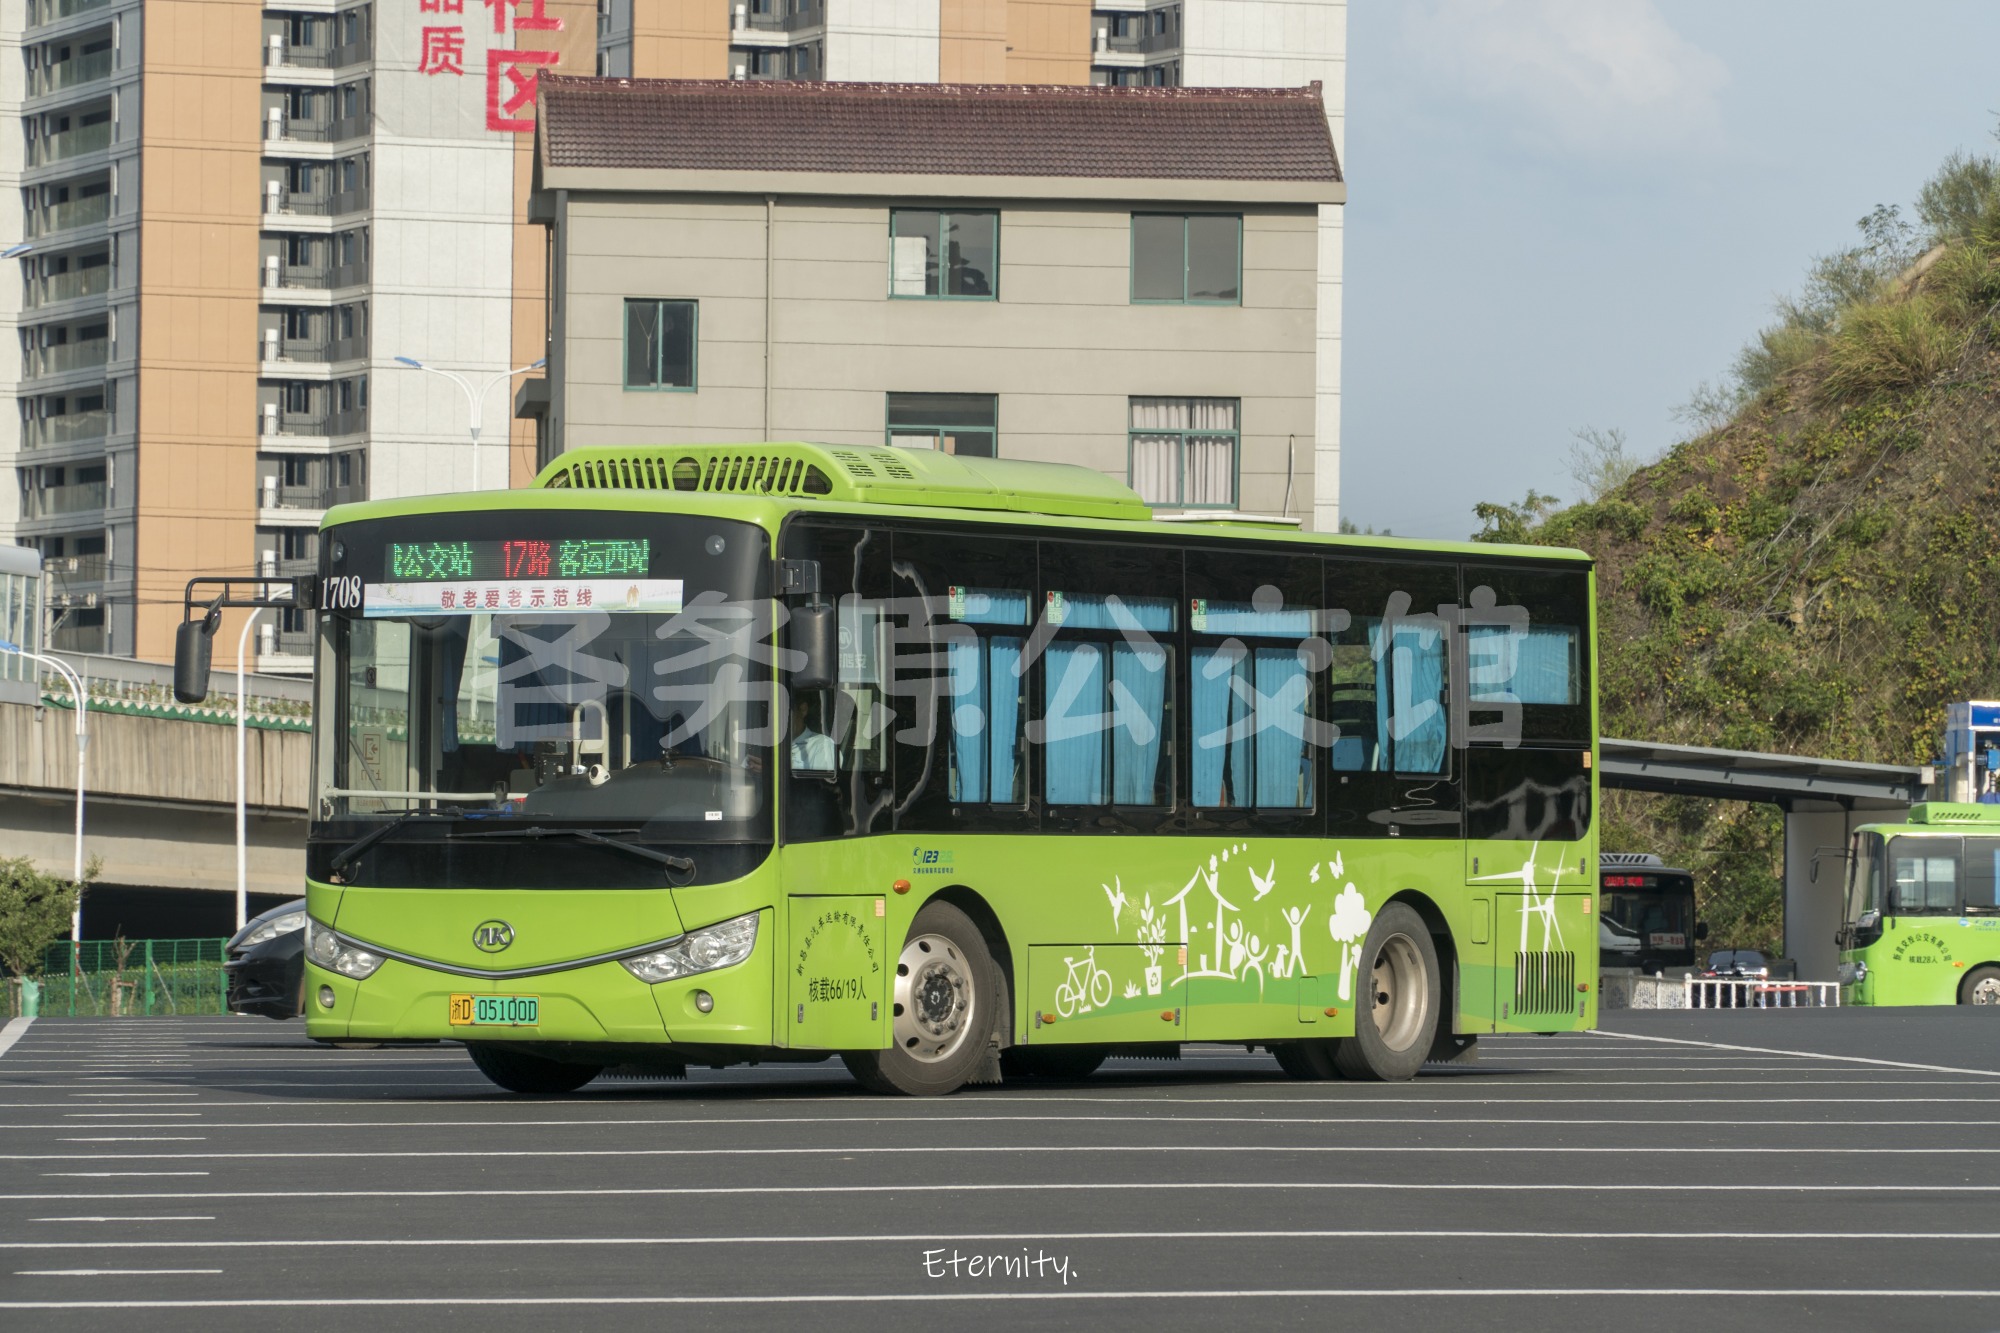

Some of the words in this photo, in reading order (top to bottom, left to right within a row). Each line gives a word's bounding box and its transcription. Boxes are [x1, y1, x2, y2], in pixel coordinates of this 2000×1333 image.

[504, 541, 551, 577] 17路
[560, 539, 650, 576] 客运西站
[321, 575, 361, 610] 1708
[441, 589, 593, 609] 敬老爱老示范线
[808, 976, 867, 1002] 核载66/19人
